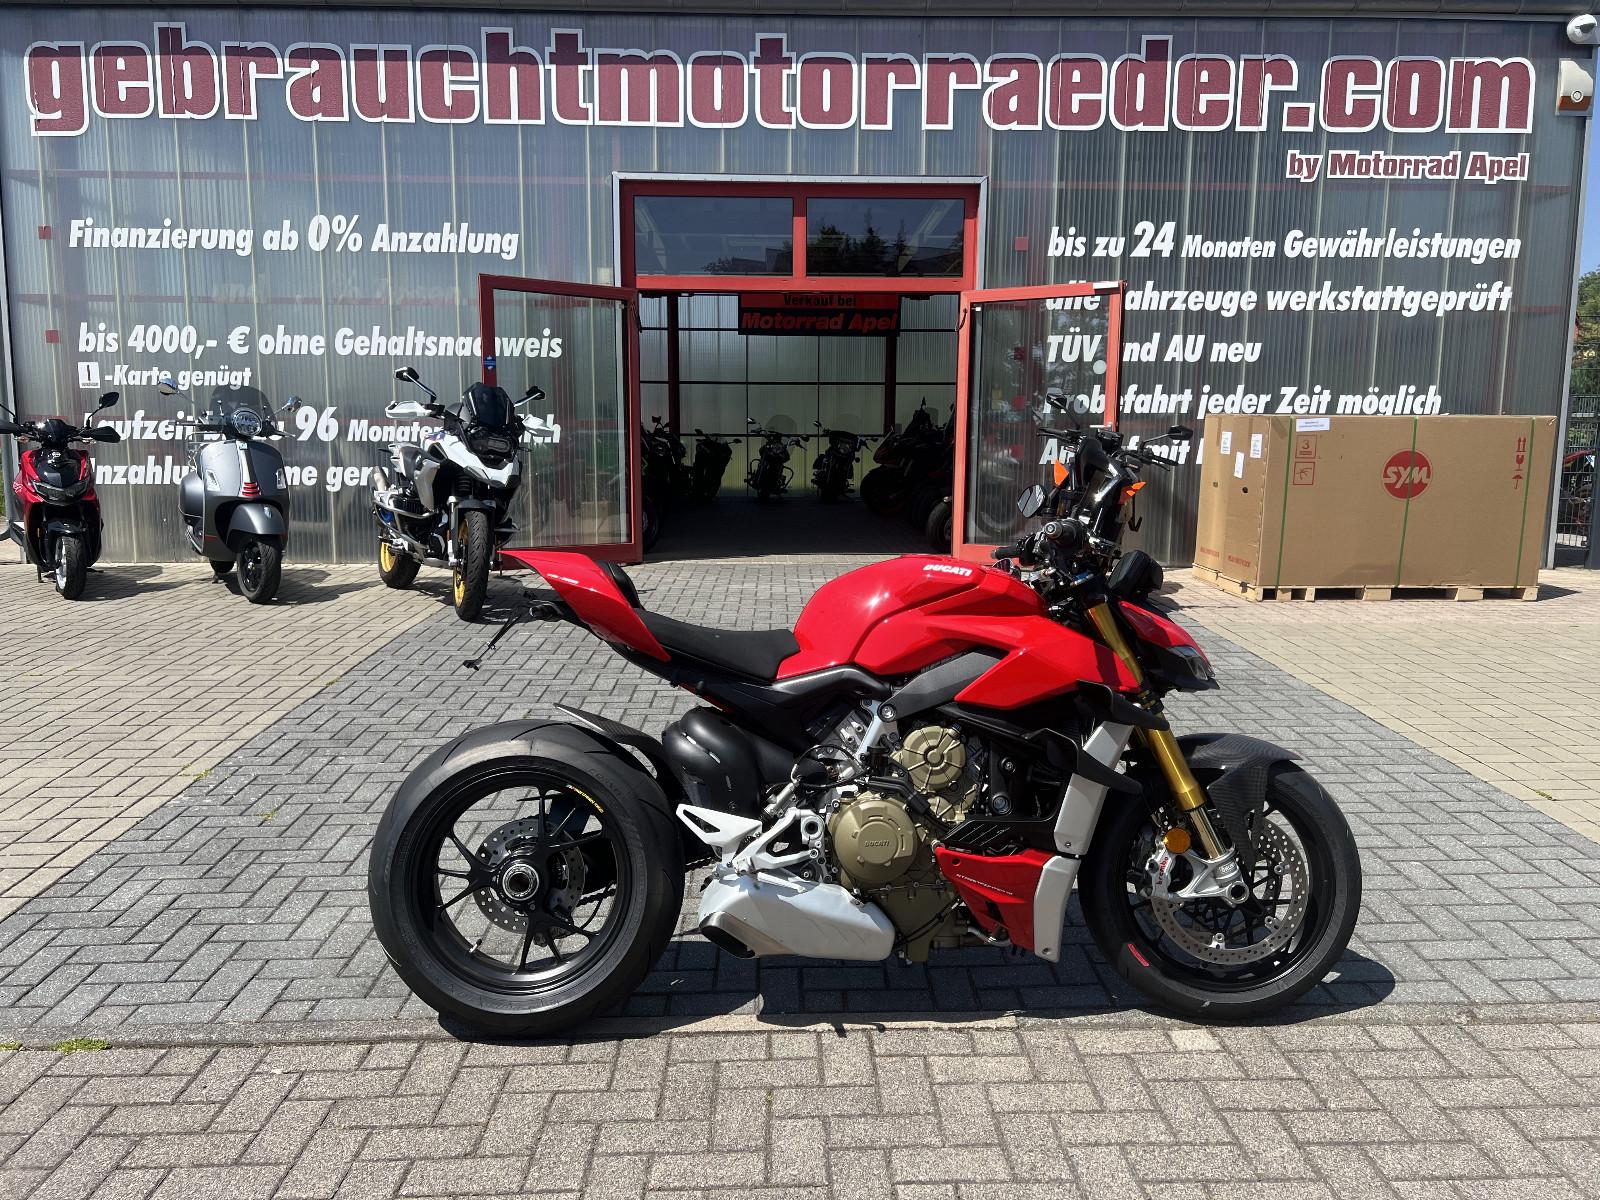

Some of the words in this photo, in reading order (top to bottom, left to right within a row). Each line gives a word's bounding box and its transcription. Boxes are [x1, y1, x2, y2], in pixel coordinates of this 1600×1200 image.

[24, 22, 1536, 136] gebrauchtmotorraeder.com
[1286, 150, 1321, 181] by
[1327, 150, 1460, 180] Motorrad
[1464, 152, 1530, 185] Apel
[69, 219, 253, 256] Finanzierung
[263, 220, 298, 252] ab
[307, 214, 363, 253] 0%
[371, 222, 519, 260] Anzahlung
[1048, 227, 1086, 258] bis
[1092, 237, 1125, 258] zu
[1130, 221, 1176, 258] 24
[1181, 235, 1276, 258] Monaten
[1283, 228, 1521, 264] Gewährleistungen
[1124, 281, 1257, 318] ahrzeuge
[1266, 281, 1513, 318] werkstattgeprüft
[741, 312, 844, 331] Motorrad
[848, 313, 898, 333] Apel
[79, 322, 118, 353] bis
[128, 325, 217, 360] 4000,-
[227, 326, 251, 355] €
[258, 324, 326, 356] ohne
[1047, 327, 1102, 363] TÜV
[1122, 332, 1161, 362] nd
[1163, 334, 1206, 362] AU
[1210, 342, 1262, 362] neu
[178, 365, 252, 391] genügt
[1197, 384, 1272, 419] jeder
[1278, 386, 1332, 414] Zeit
[1336, 385, 1441, 416] möglich
[295, 405, 339, 442] 96
[1383, 466, 1430, 489] SYM
[923, 564, 973, 577] DUCATI
